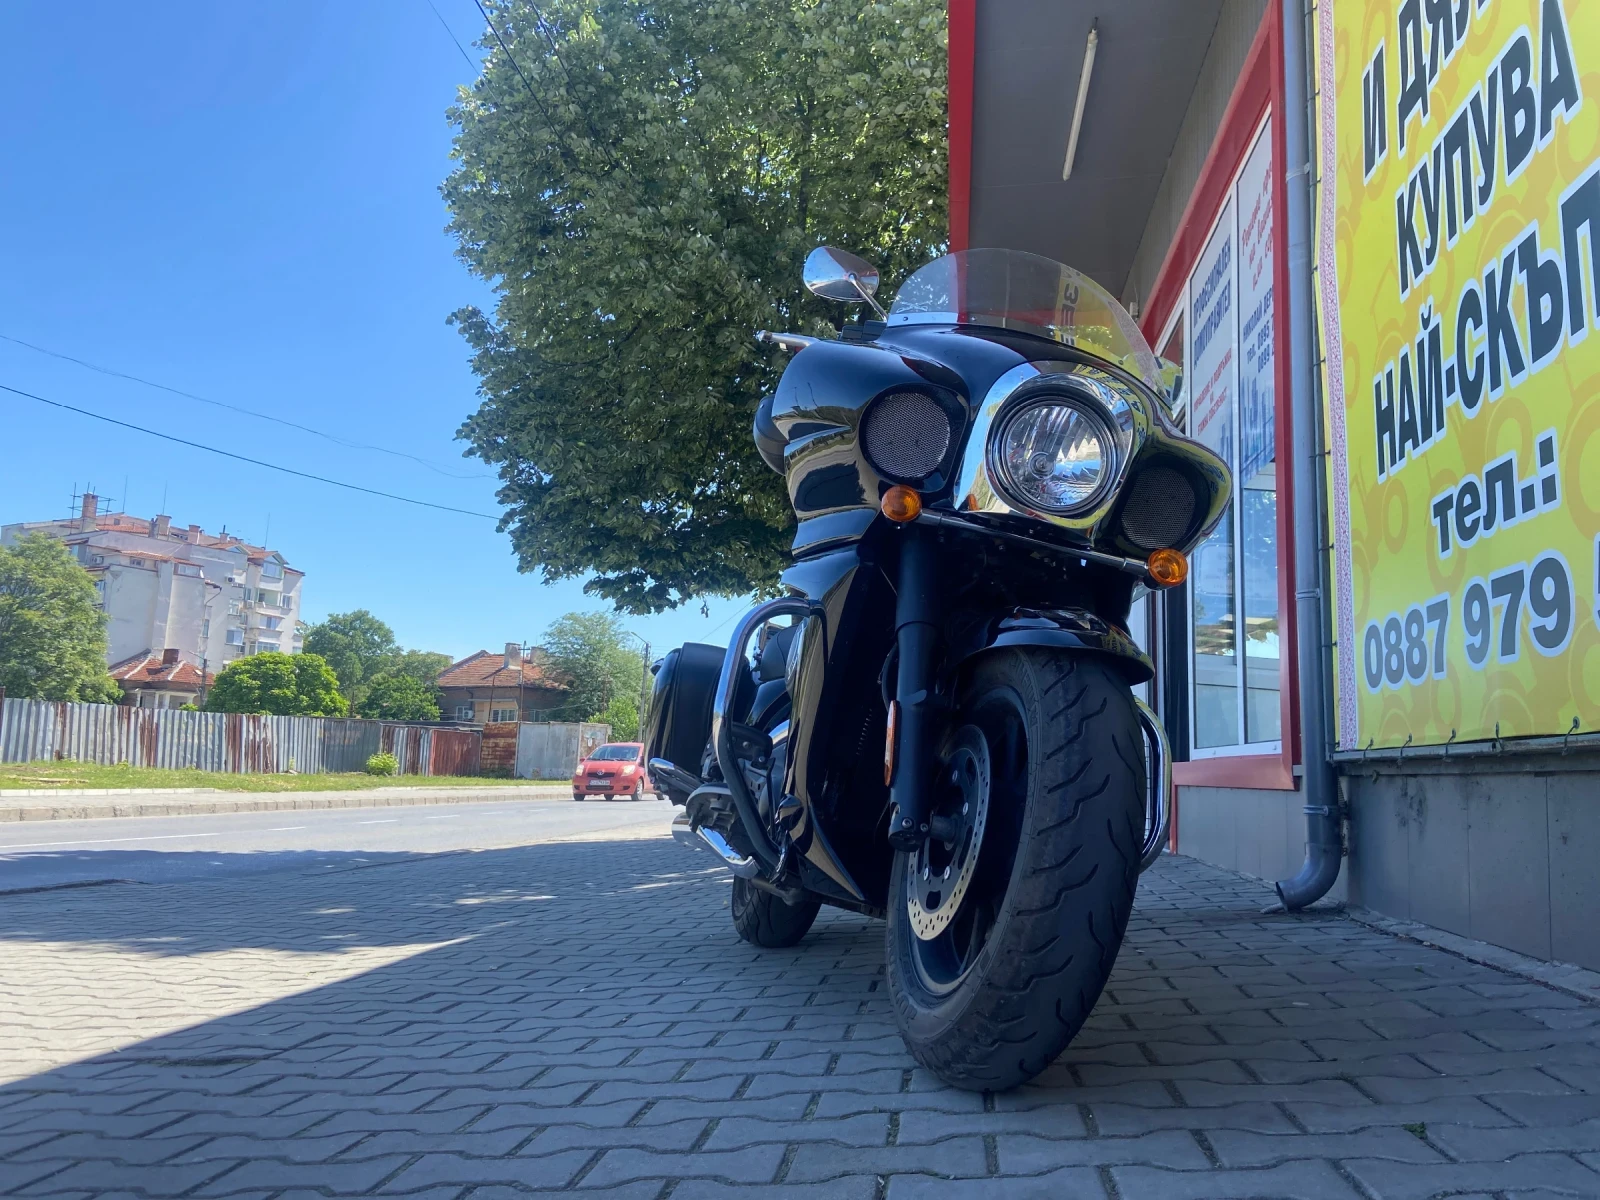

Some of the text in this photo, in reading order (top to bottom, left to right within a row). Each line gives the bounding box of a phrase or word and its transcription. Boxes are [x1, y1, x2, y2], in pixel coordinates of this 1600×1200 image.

[1362, 0, 1486, 179] И ДЯ
[1396, 0, 1580, 296] КУПУВА
[1364, 598, 1449, 689] 0887
[1464, 557, 1572, 666] 979
